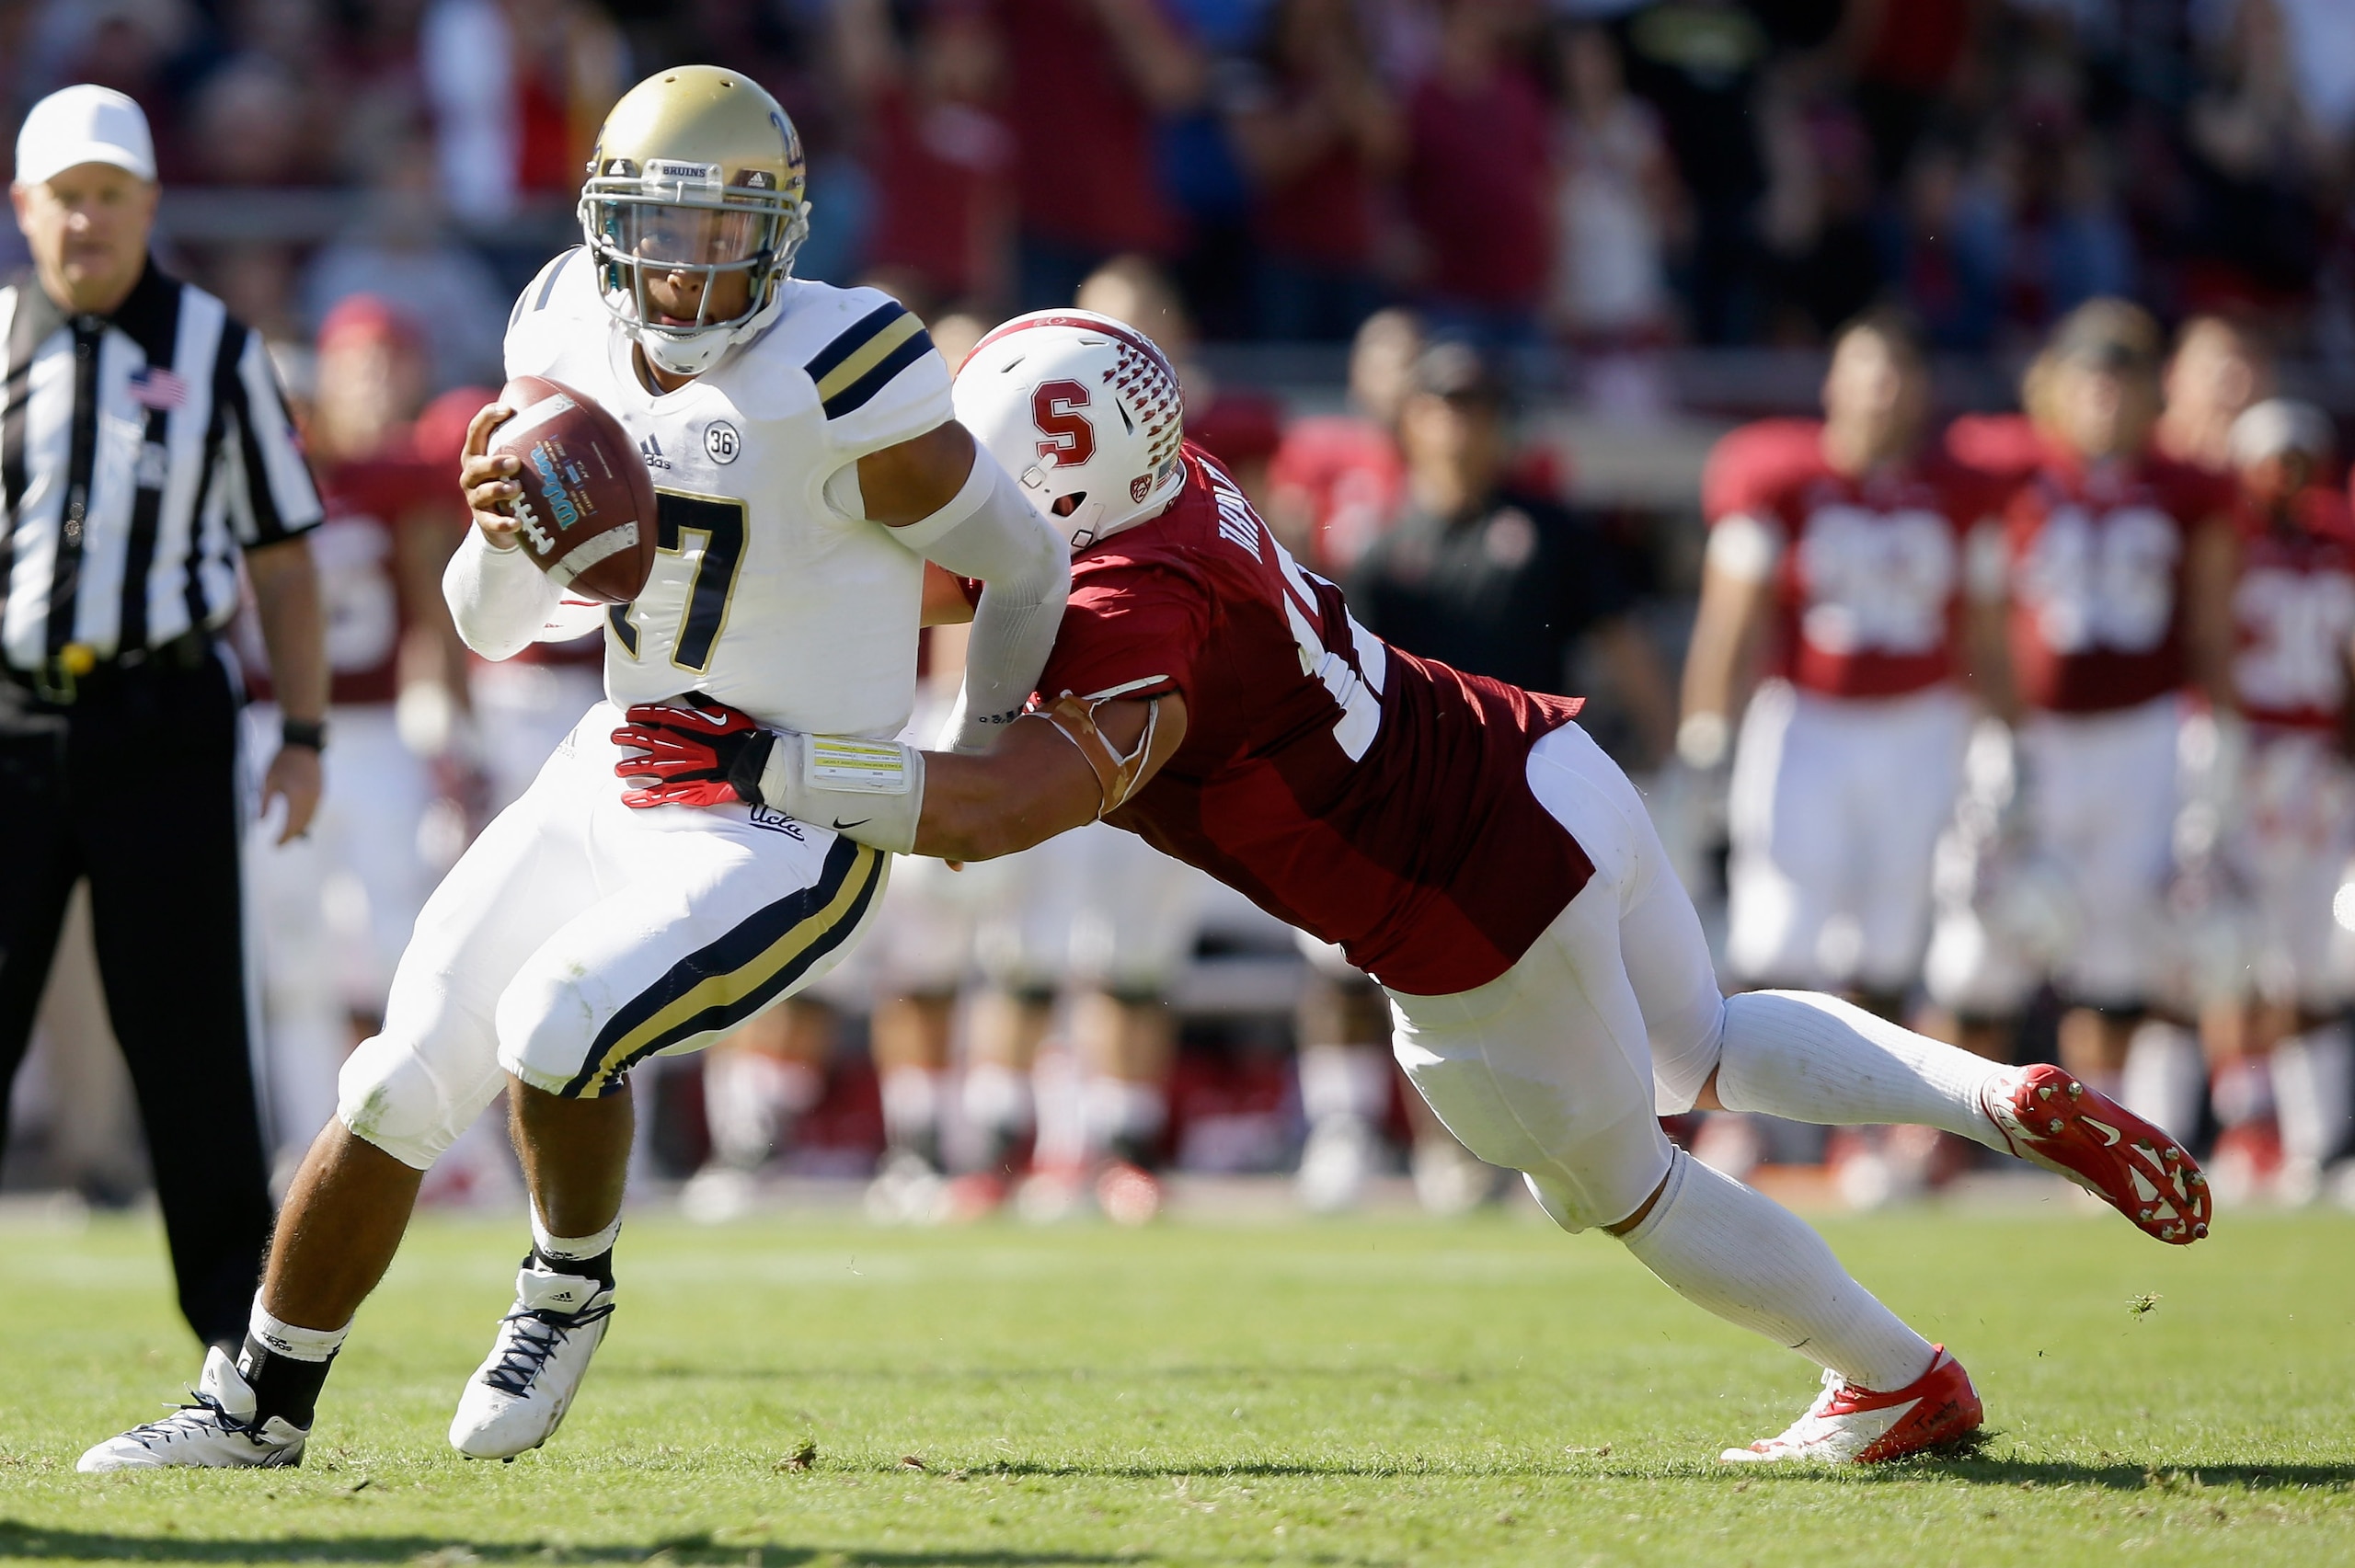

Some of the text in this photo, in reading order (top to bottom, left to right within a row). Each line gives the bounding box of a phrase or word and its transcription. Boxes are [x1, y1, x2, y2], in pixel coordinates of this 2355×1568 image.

[662, 166, 706, 178] BRUINS
[1031, 378, 1097, 467] S
[710, 429, 733, 455] 36
[644, 453, 672, 470] das
